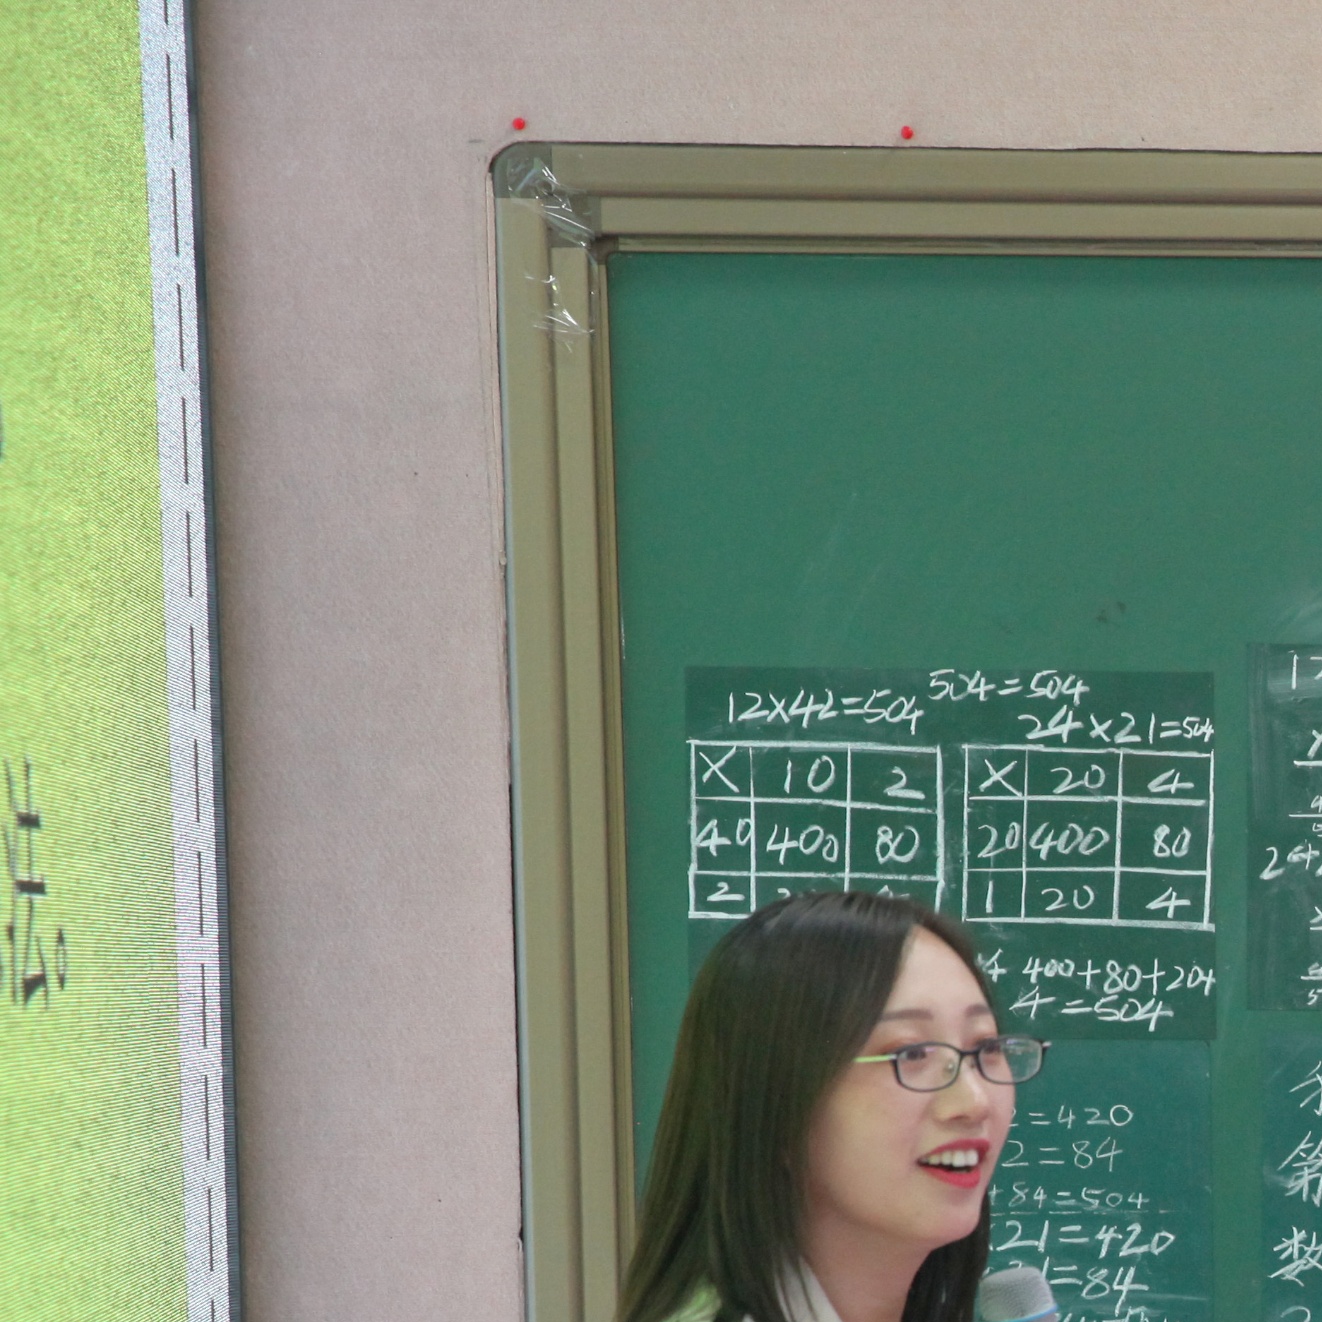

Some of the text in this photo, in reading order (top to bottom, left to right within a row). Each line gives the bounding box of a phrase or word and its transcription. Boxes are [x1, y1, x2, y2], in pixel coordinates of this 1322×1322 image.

[928, 669, 1090, 704] 504=504
[783, 755, 835, 793] 10
[886, 767, 926, 800] 2
[1050, 764, 1106, 792] 20
[1148, 768, 1194, 794] 4
[694, 817, 919, 864] 40 400 80
[977, 821, 1191, 858] 20 400 80
[707, 882, 745, 903] 2
[984, 880, 1191, 918] 1 20 4
